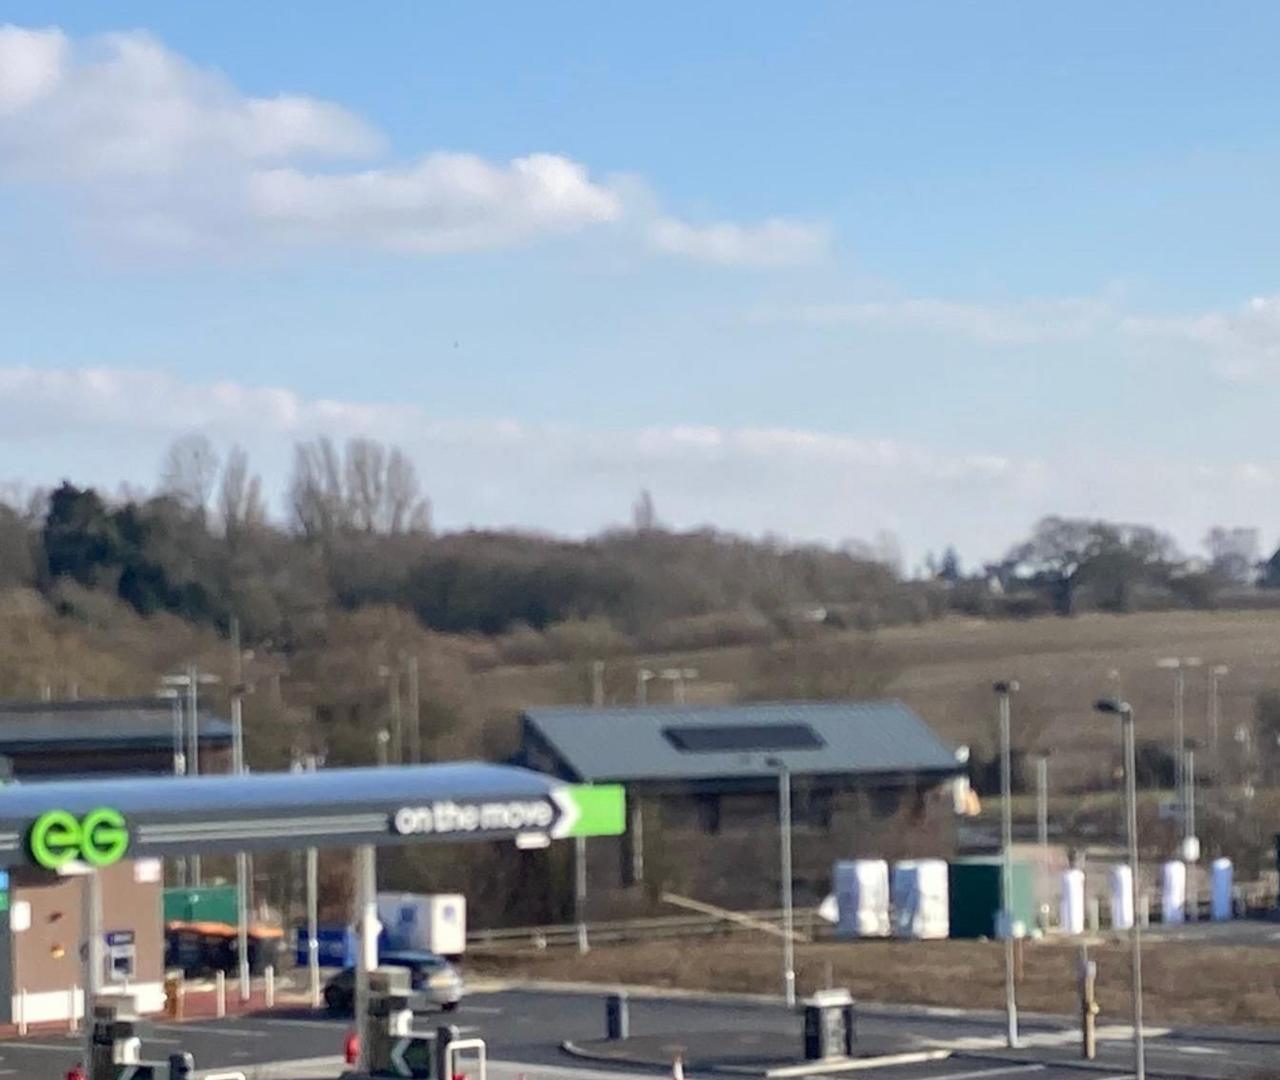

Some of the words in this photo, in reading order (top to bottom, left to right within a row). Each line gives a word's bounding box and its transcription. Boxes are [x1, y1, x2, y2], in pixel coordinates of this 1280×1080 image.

[395, 807, 433, 835] on
[433, 800, 480, 833] the
[480, 801, 554, 830] move
